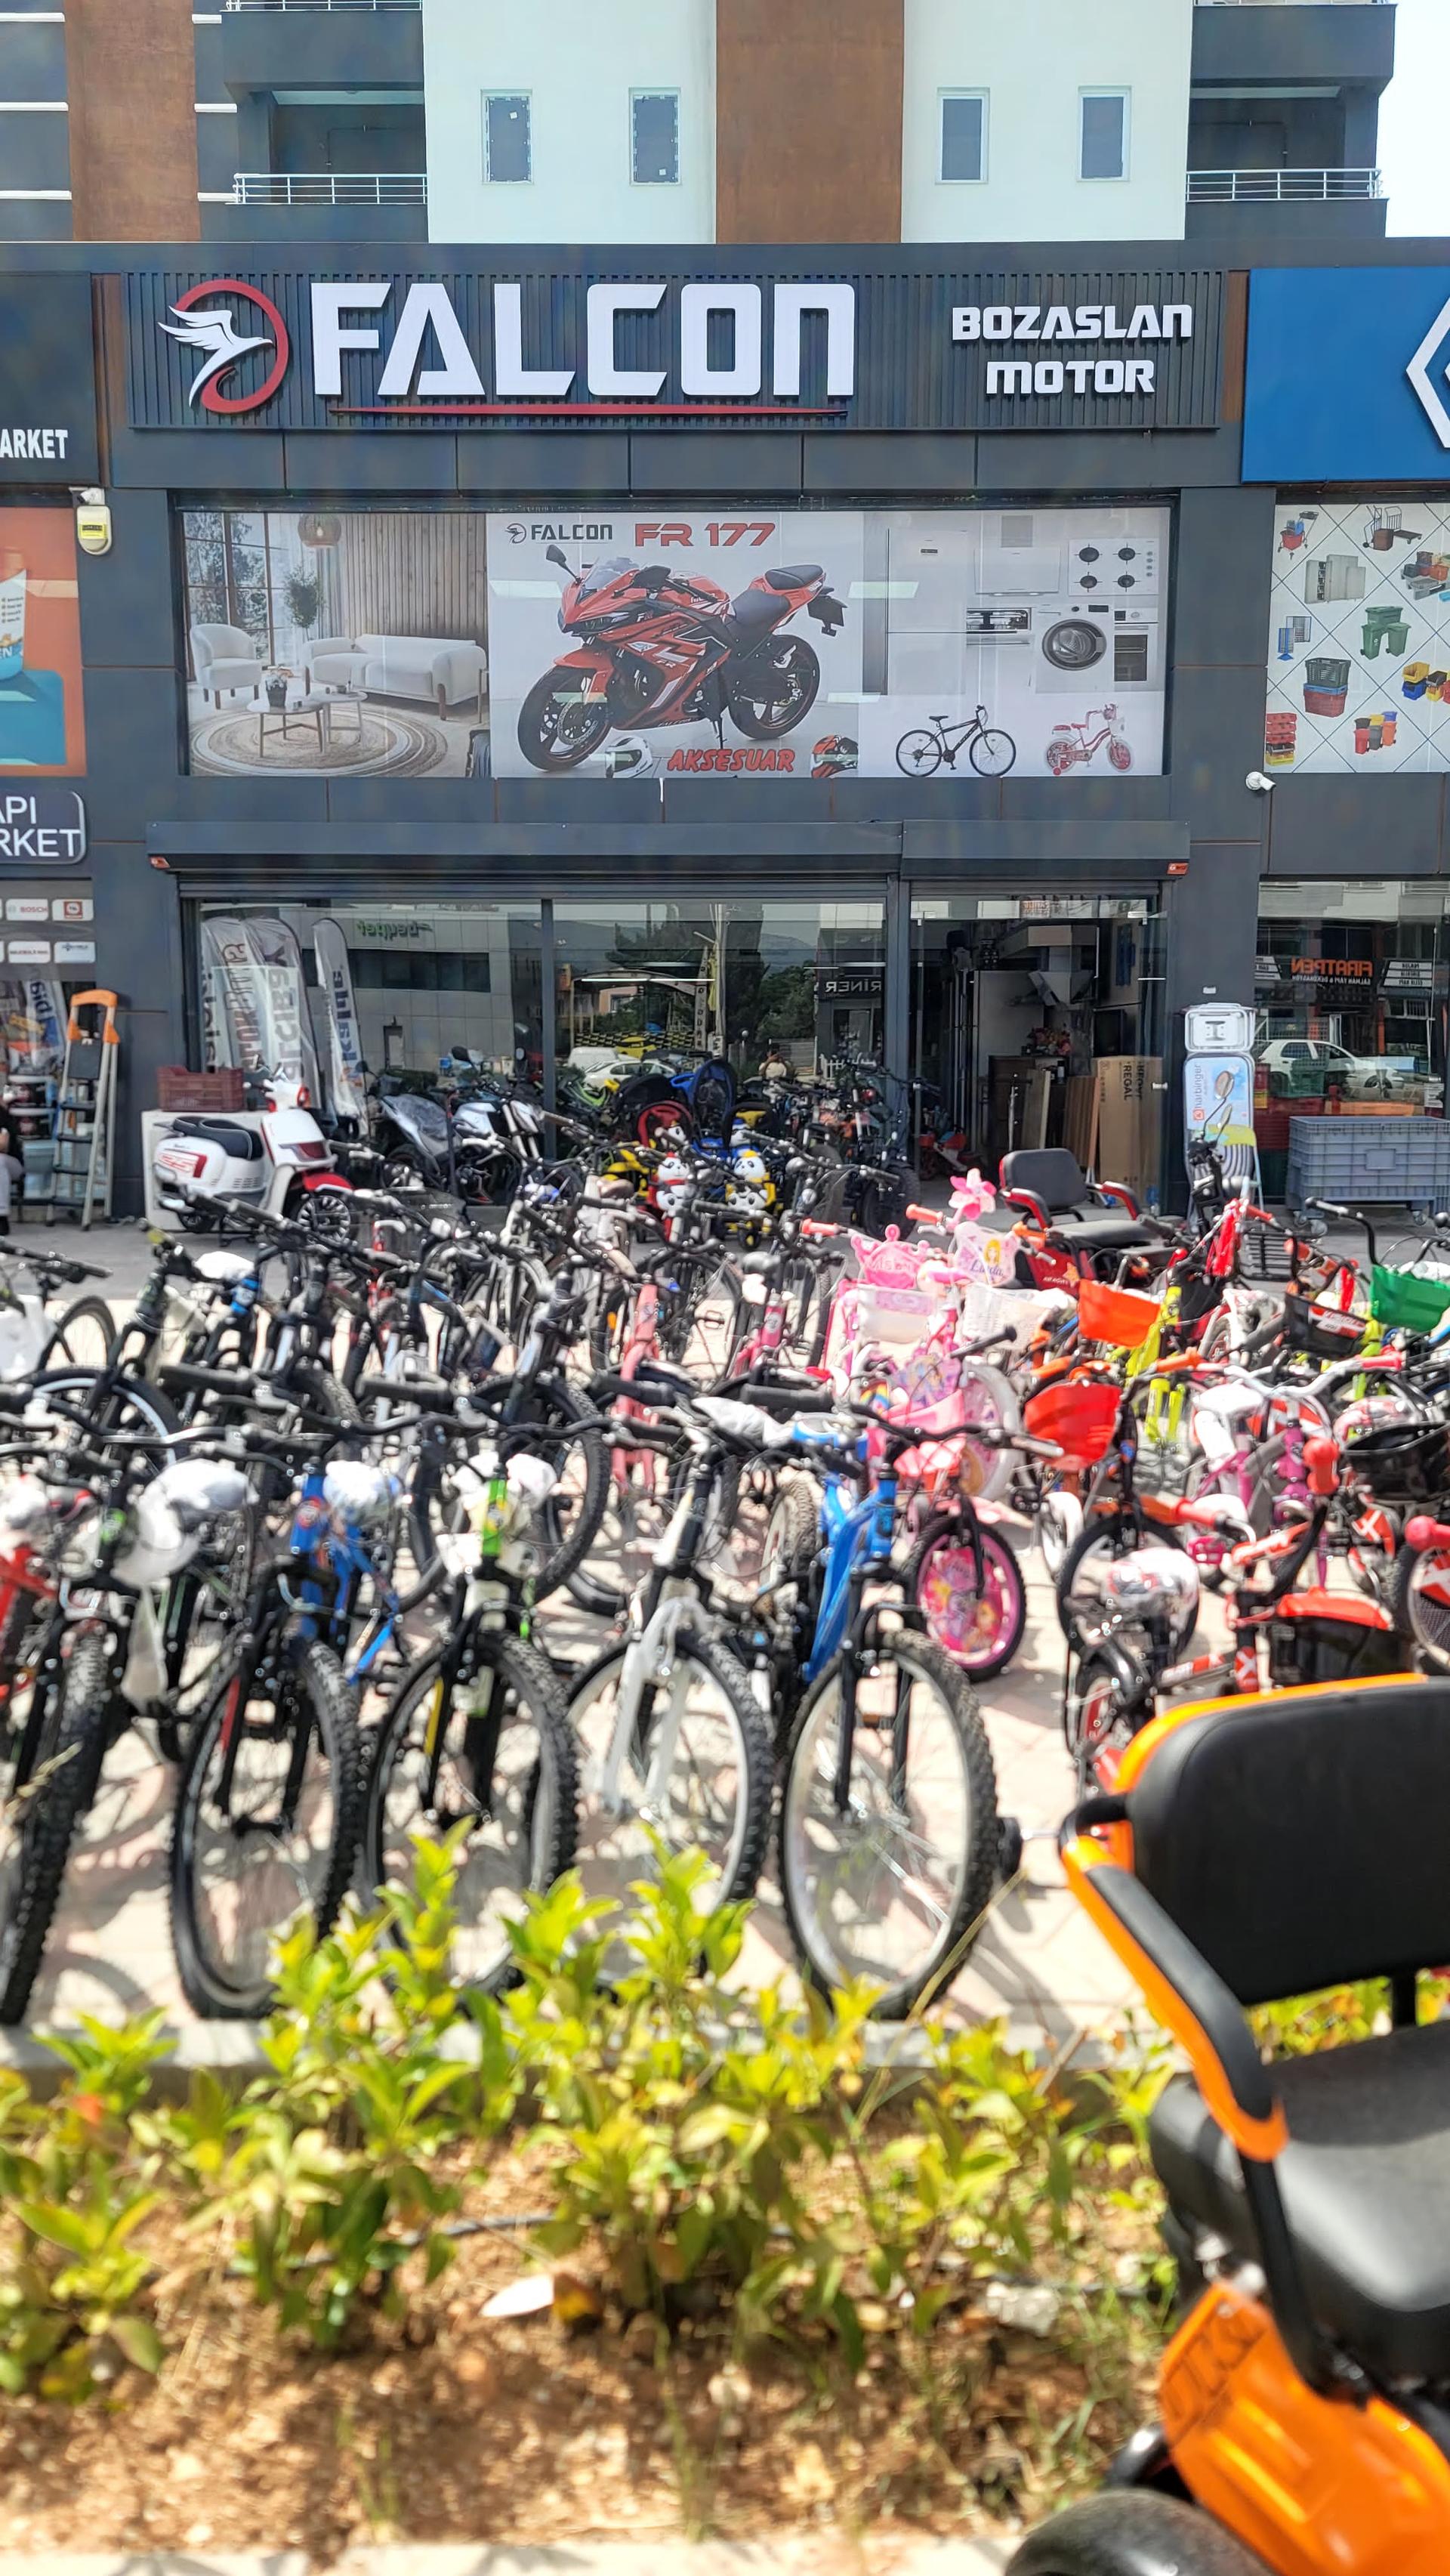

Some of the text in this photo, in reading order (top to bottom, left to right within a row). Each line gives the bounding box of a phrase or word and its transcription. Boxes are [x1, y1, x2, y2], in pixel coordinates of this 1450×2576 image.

[952, 304, 1192, 340] BOZASLAN
[310, 283, 855, 396] FALCON
[986, 360, 1155, 394] MOTOR
[531, 524, 613, 540] FALCON
[634, 523, 776, 547] FR 177
[667, 749, 795, 772] AKSESUAR
[0, 795, 37, 824] PI
[1123, 1064, 1133, 1101] REGAL
